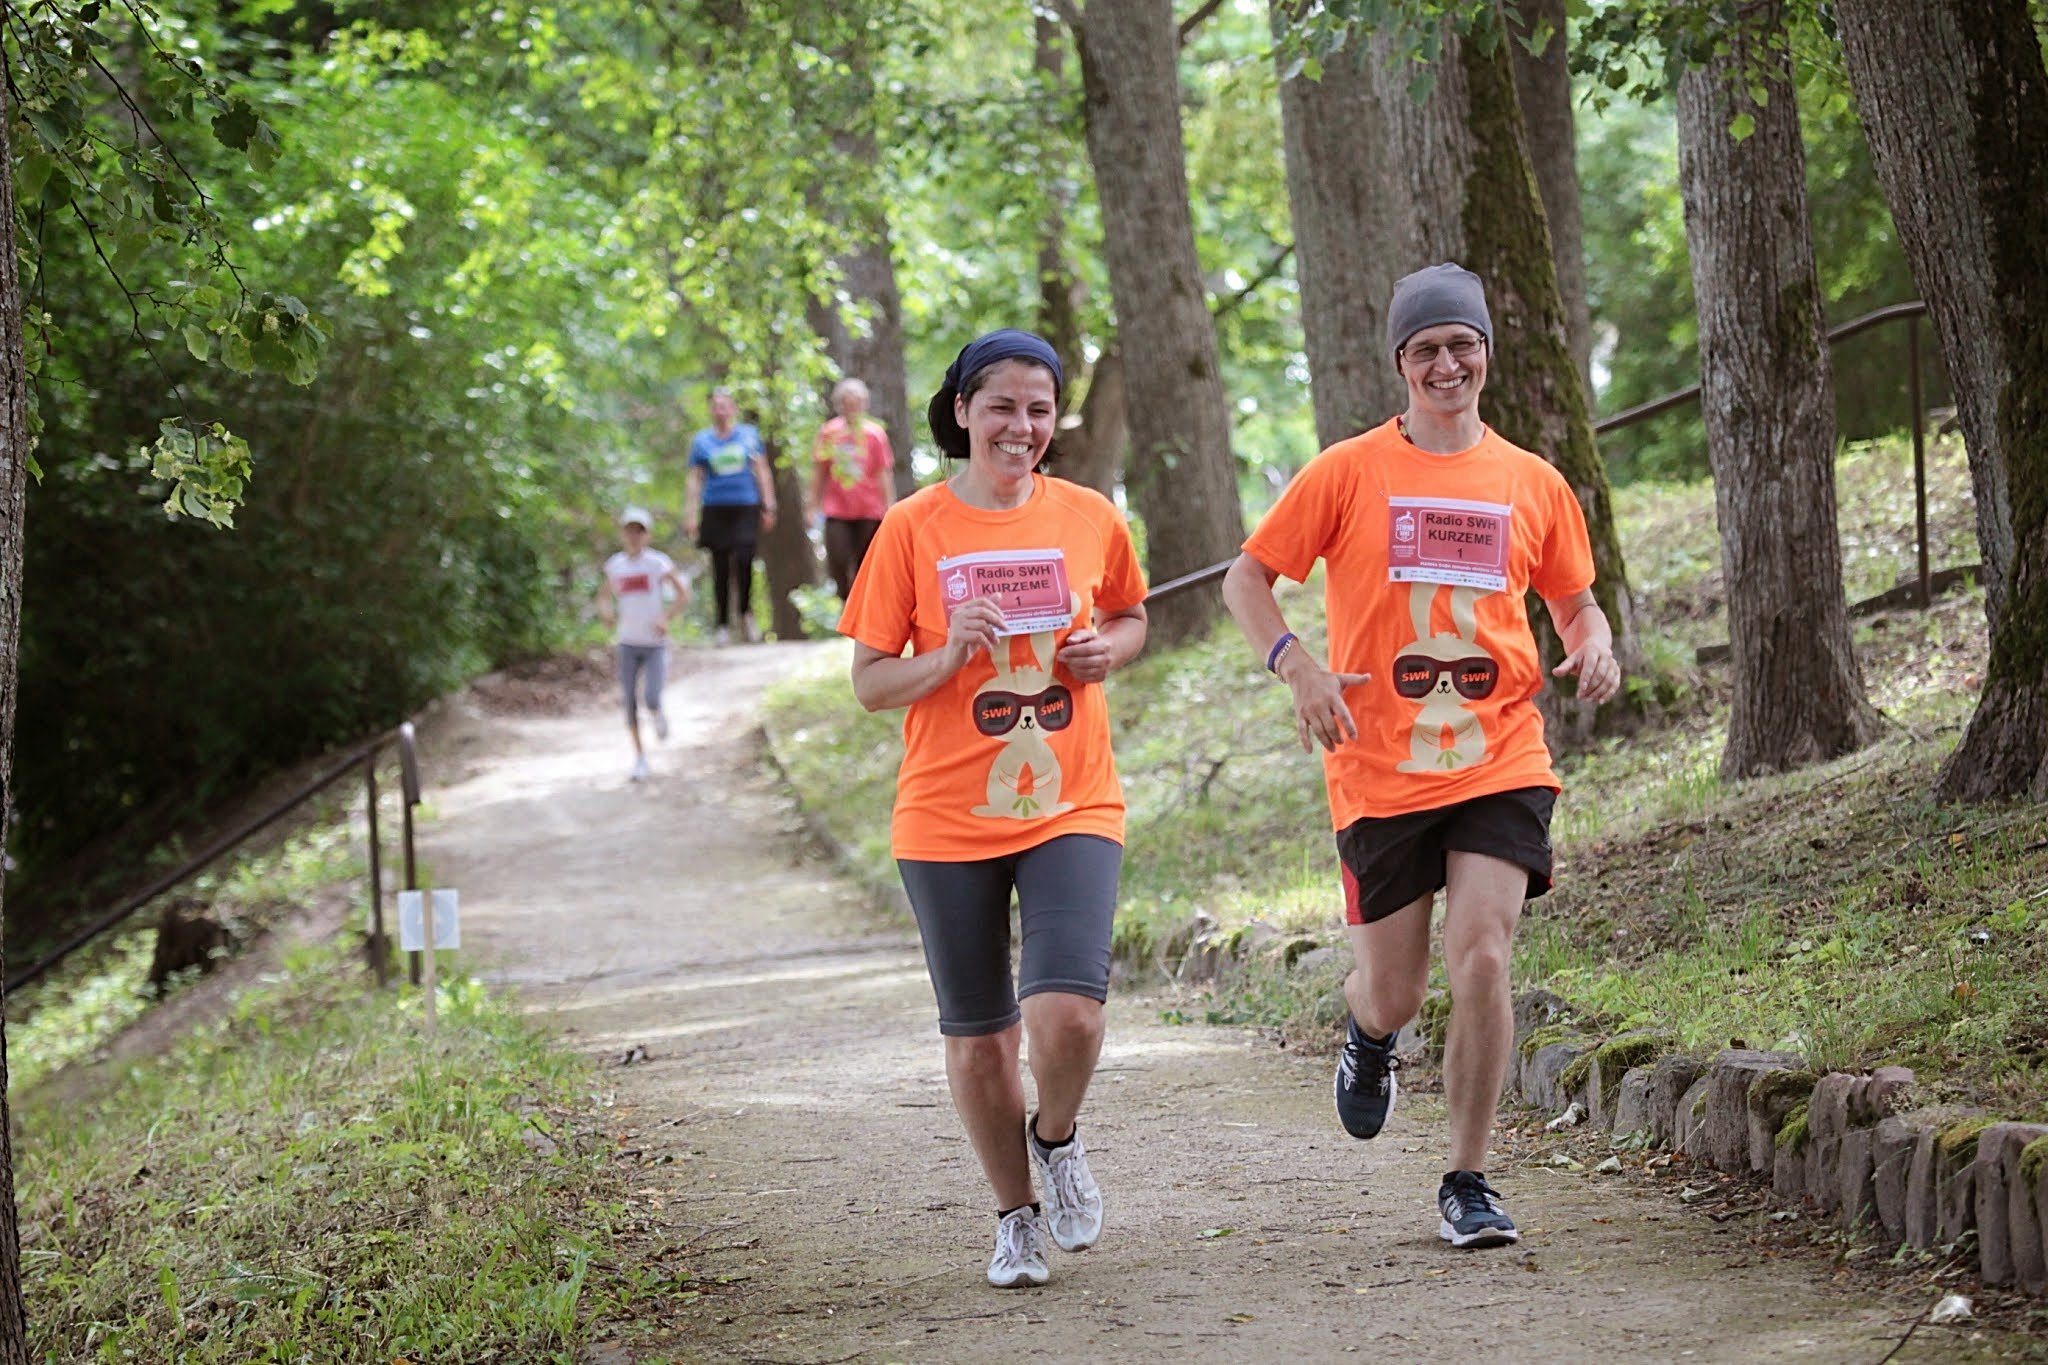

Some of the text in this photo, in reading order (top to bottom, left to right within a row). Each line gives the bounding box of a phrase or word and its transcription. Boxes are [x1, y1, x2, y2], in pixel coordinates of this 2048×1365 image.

[1426, 513, 1496, 529] Radio SWH
[1428, 530, 1493, 545] KURZEME
[1457, 548, 1463, 558] 1
[976, 565, 1051, 579] Radio SWH
[981, 579, 1051, 594] KURZEME
[1016, 597, 1022, 606] 1
[1401, 670, 1430, 682] SWH
[1461, 672, 1490, 683] SWH
[981, 706, 1012, 720] SWH
[1039, 699, 1065, 716] SWH
